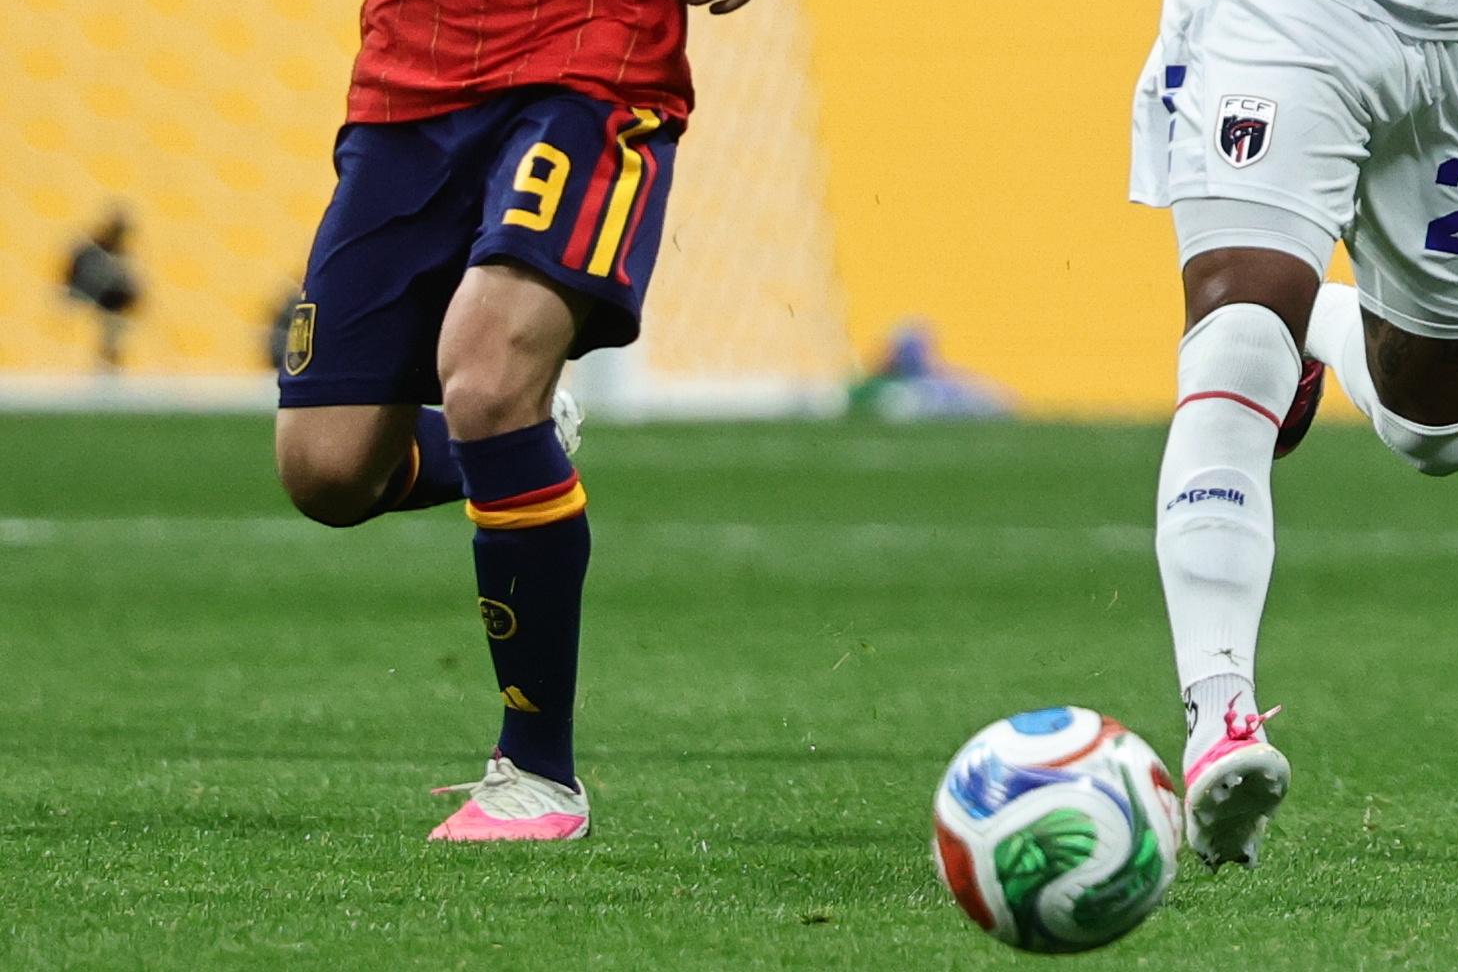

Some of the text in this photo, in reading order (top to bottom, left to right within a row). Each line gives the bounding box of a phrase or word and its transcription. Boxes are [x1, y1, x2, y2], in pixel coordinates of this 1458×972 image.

[1225, 99, 1271, 112] FCF
[502, 142, 570, 231] 9
[1167, 488, 1244, 510] capelli
